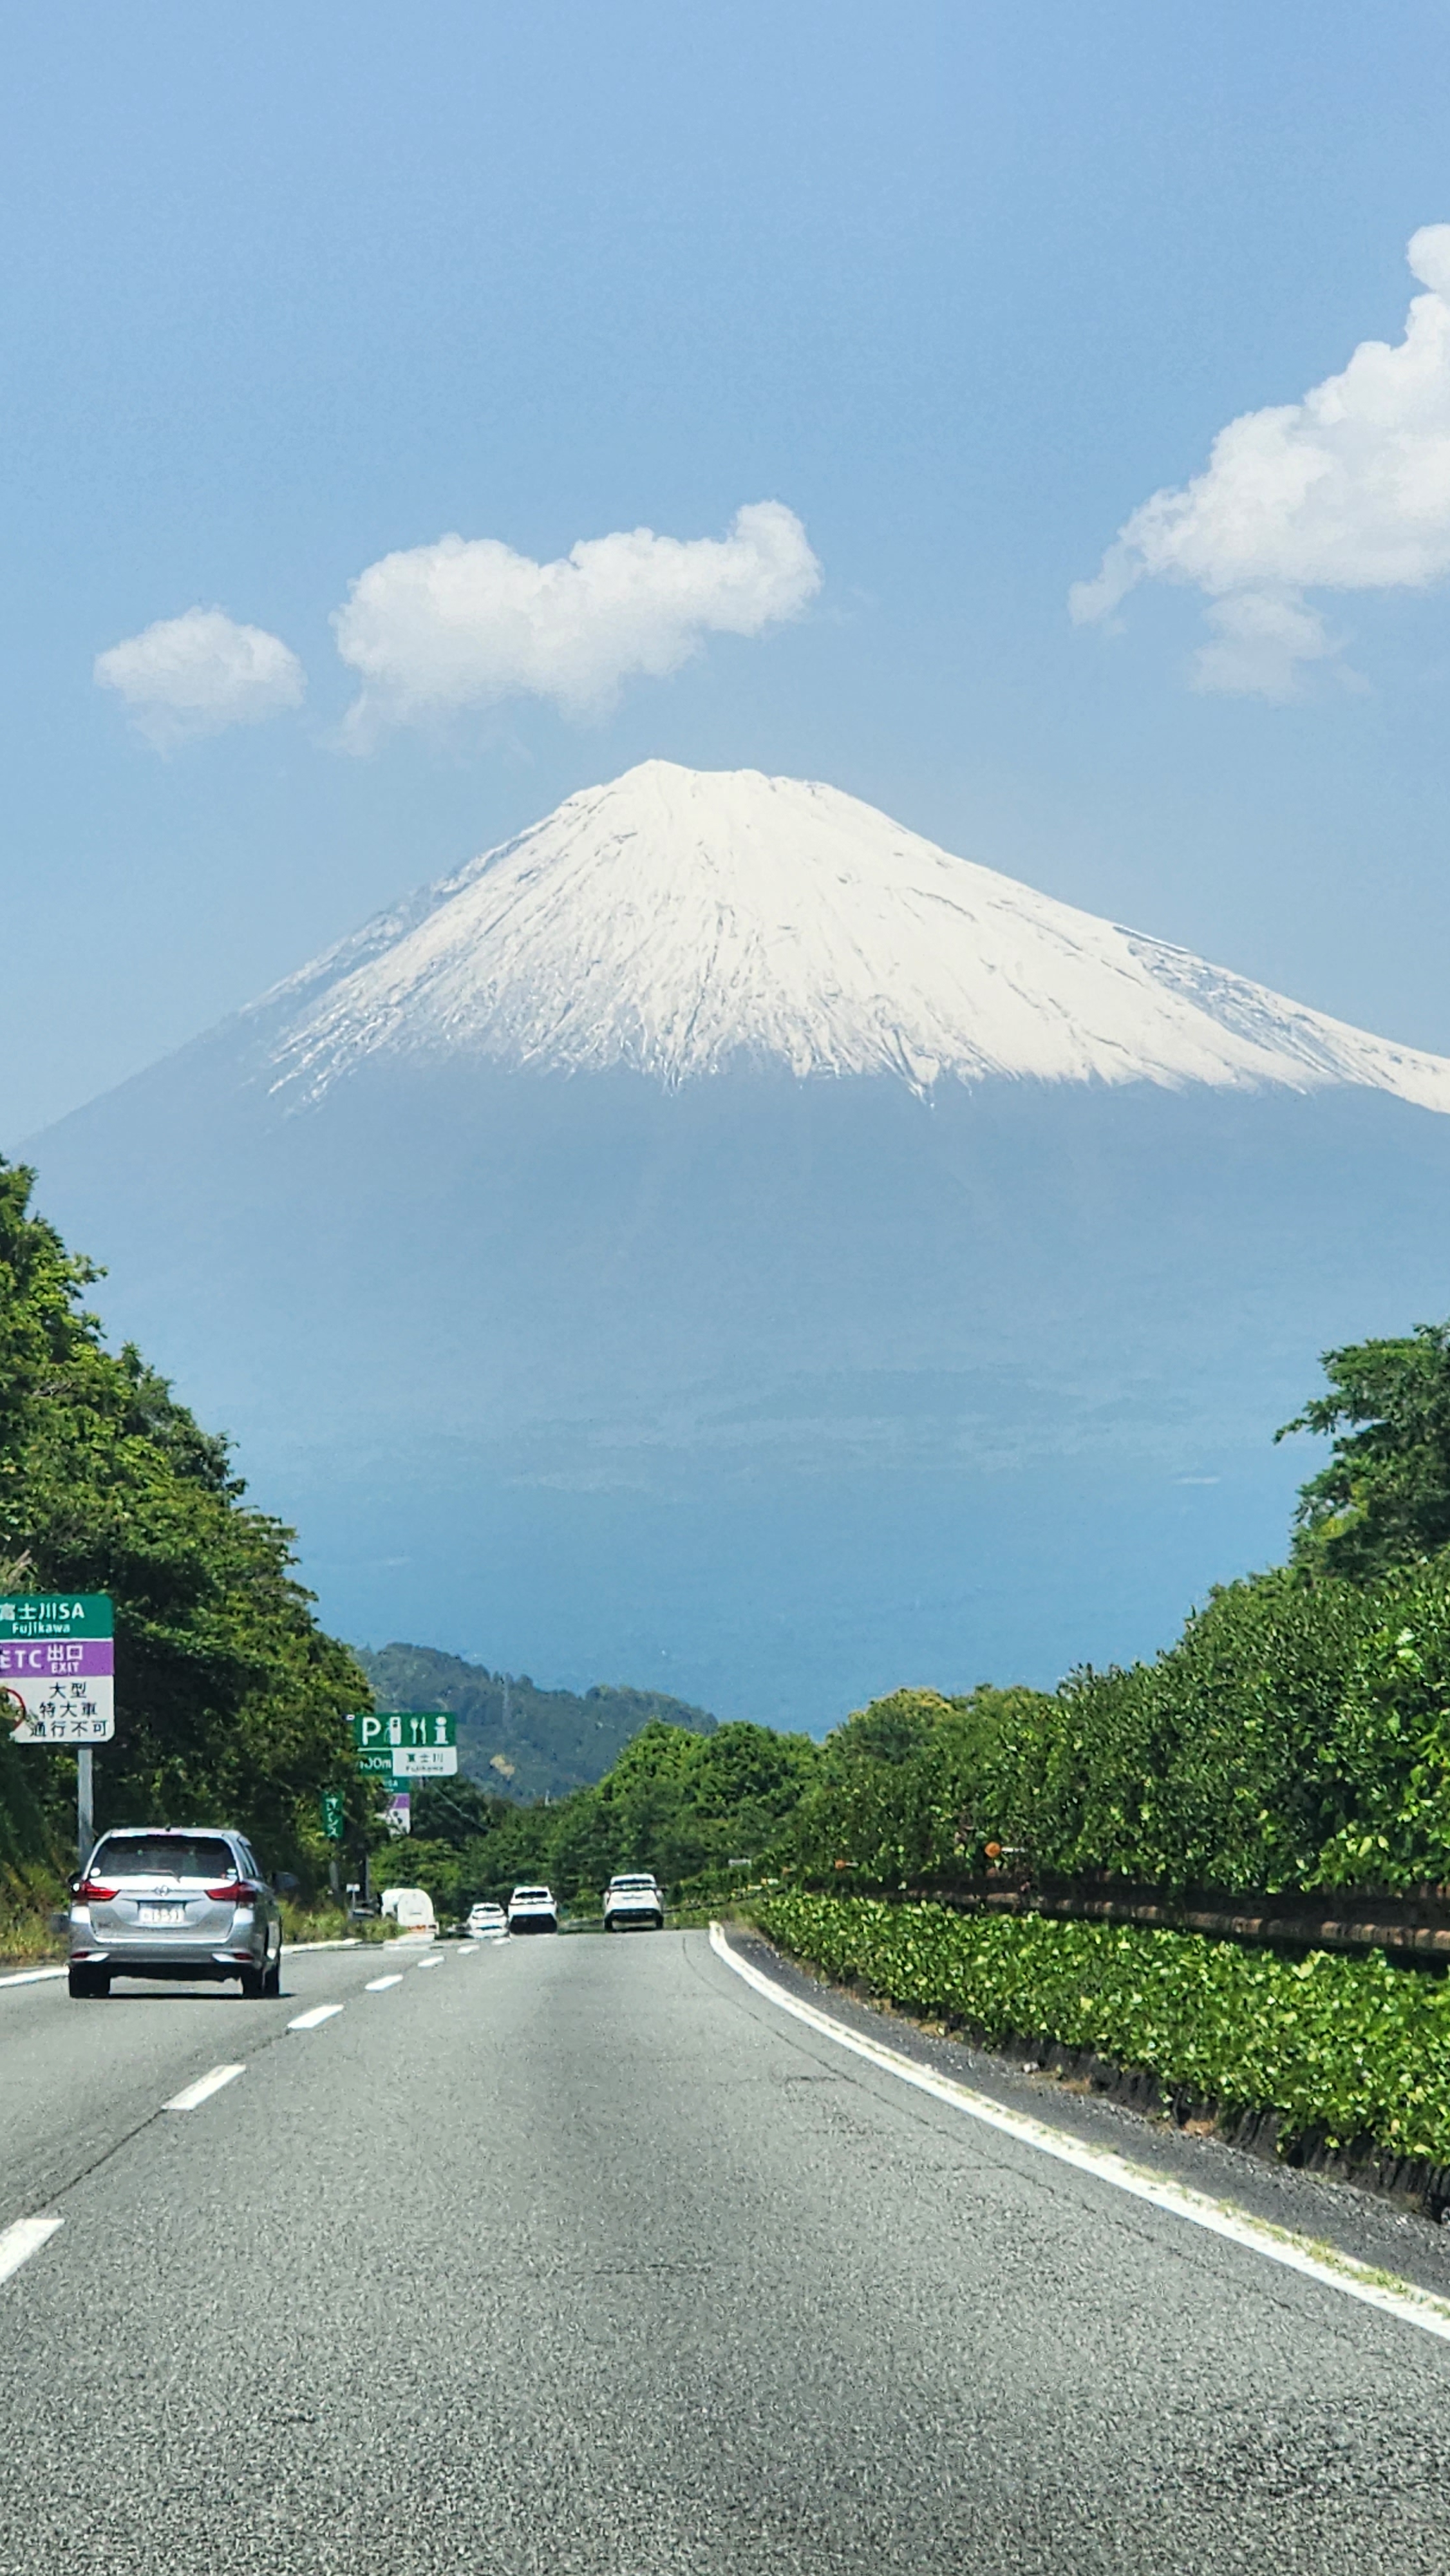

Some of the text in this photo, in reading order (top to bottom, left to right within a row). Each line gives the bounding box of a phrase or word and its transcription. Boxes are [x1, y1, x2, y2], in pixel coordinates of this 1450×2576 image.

[0, 1602, 85, 1621] 富士川SA
[12, 1622, 71, 1636] Fujikawa
[0, 1643, 83, 1669] ETC 出口
[51, 1661, 79, 1674] EXIT
[50, 1681, 87, 1699] 大型
[39, 1701, 97, 1719] 特大車
[30, 1719, 108, 1737] 通行不可
